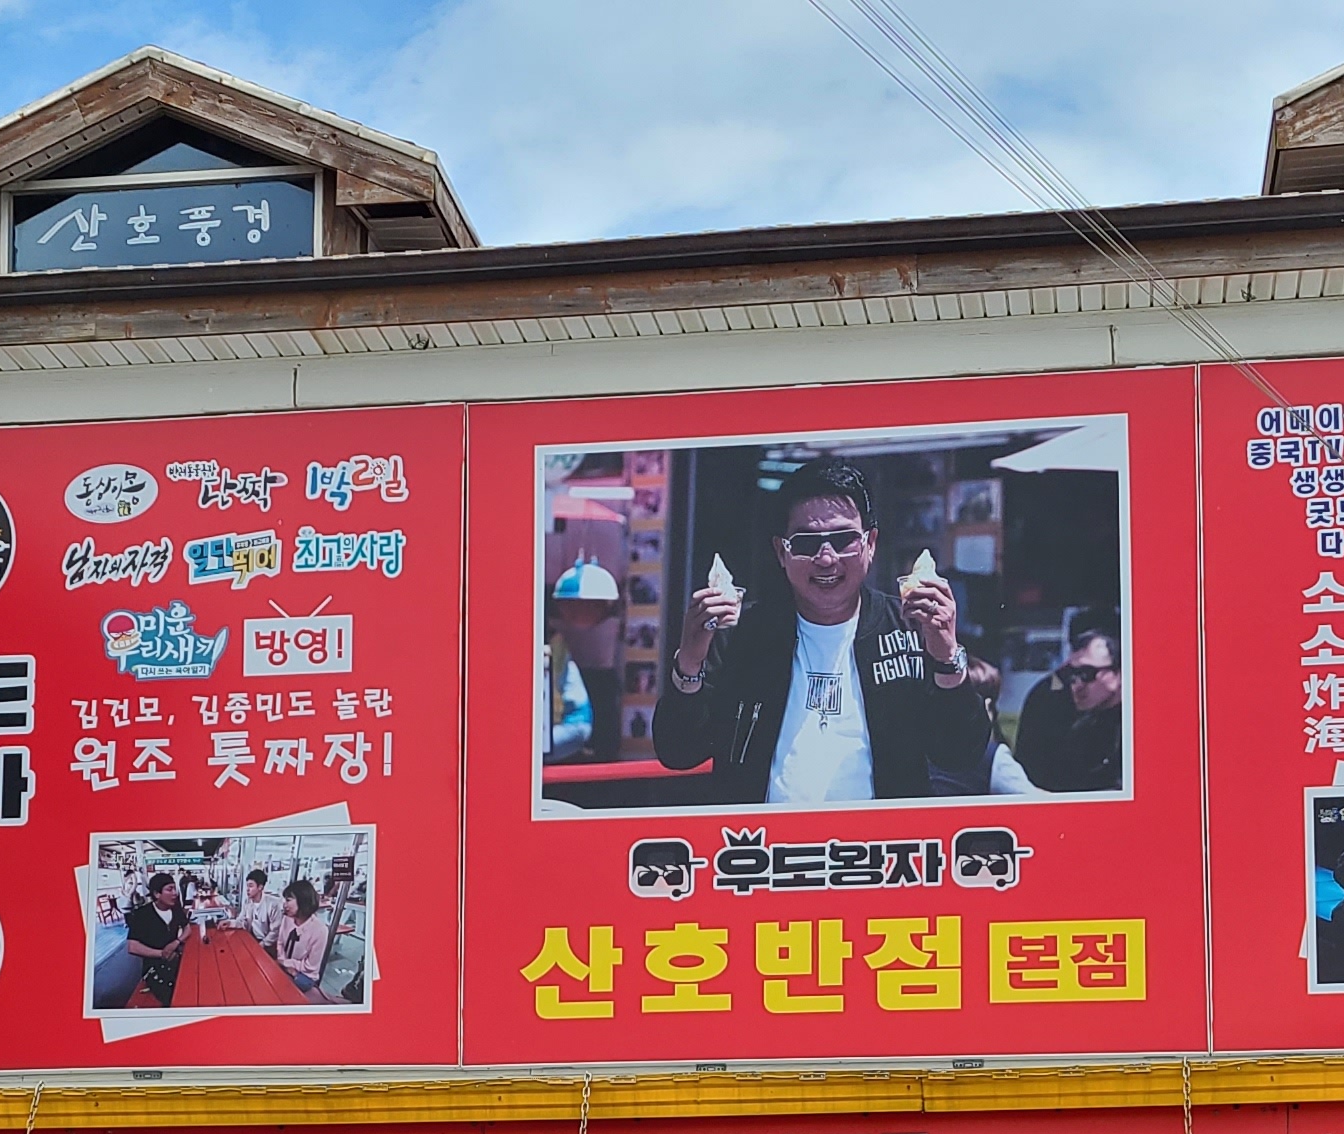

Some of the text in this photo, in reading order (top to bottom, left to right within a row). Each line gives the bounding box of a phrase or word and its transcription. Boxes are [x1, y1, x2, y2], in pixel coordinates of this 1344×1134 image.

[37, 199, 273, 253] 산호풍경
[75, 470, 146, 505] 동상이몽
[203, 468, 284, 509] 단짝
[140, 603, 194, 637] 미운
[254, 628, 343, 666] 방영!
[70, 688, 393, 730] 김건모, 김종민도 놀란
[69, 730, 393, 792] 원조 톳짜장!
[716, 844, 942, 892] 우도왕자
[520, 915, 1128, 1020] 산호반점 본점
